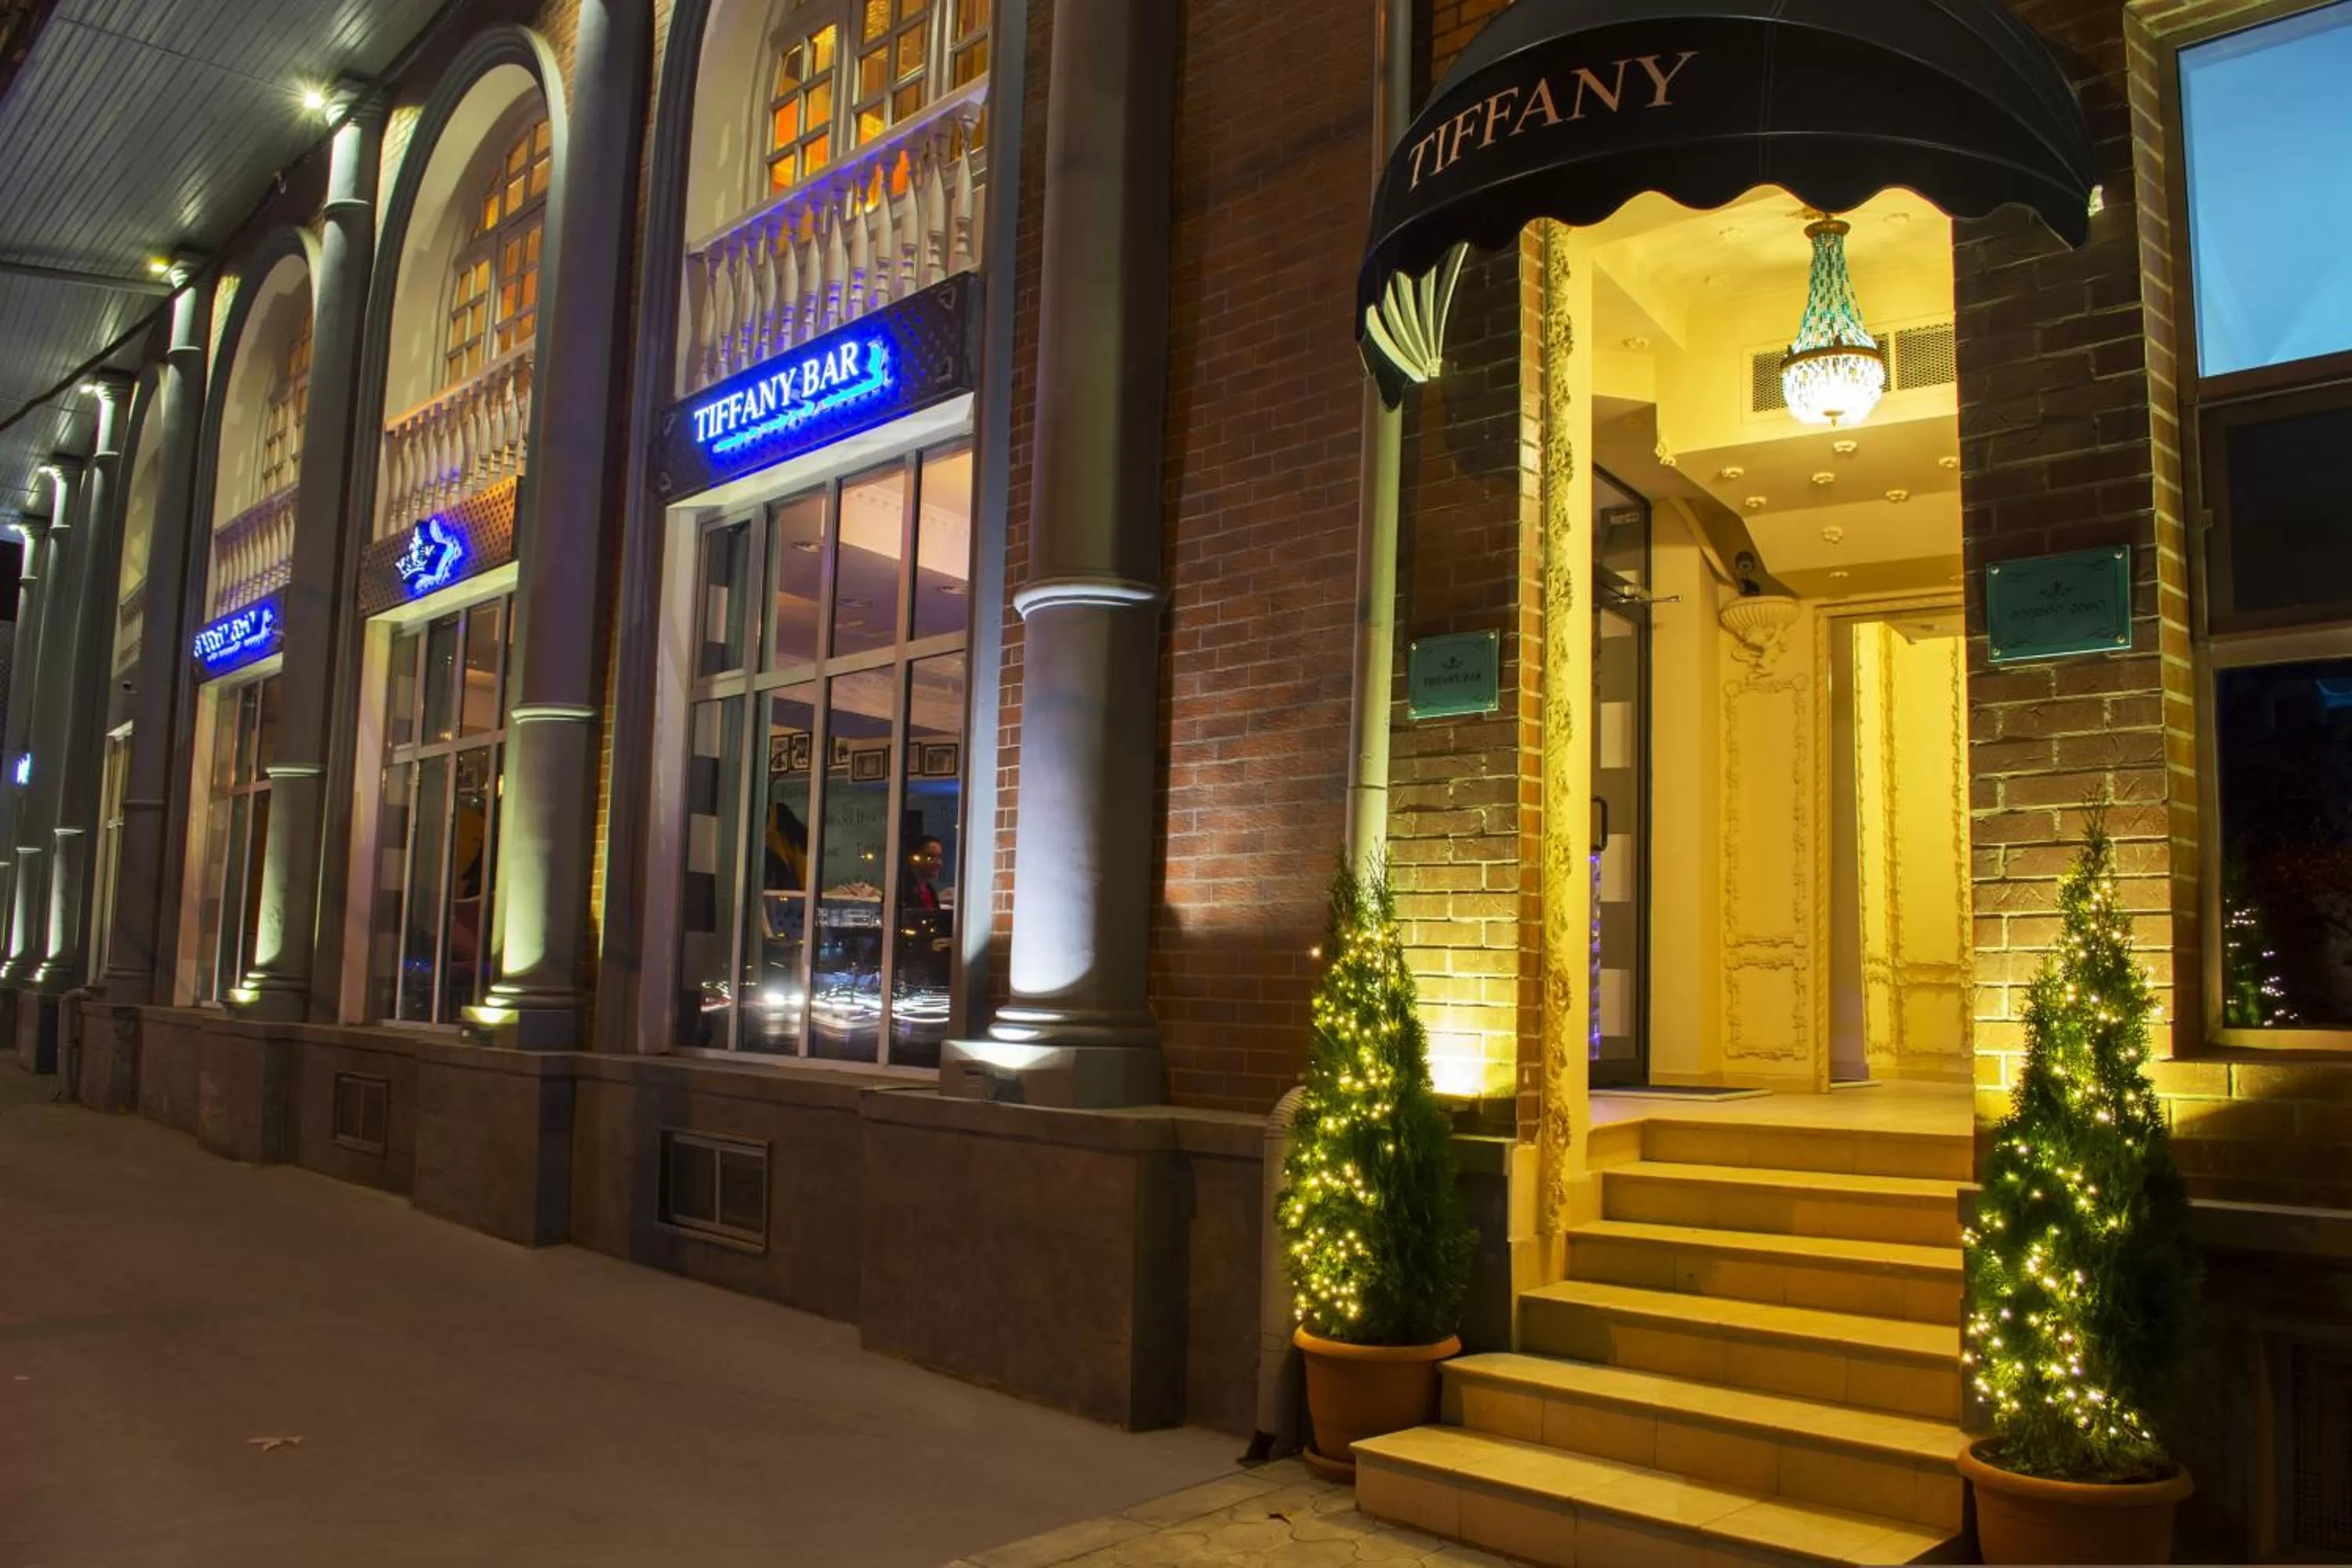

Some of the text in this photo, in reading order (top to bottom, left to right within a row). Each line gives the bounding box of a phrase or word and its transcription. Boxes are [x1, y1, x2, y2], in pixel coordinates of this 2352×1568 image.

[1407, 51, 1700, 193] TIFFANY
[694, 341, 859, 443] TIFFANY BAR
